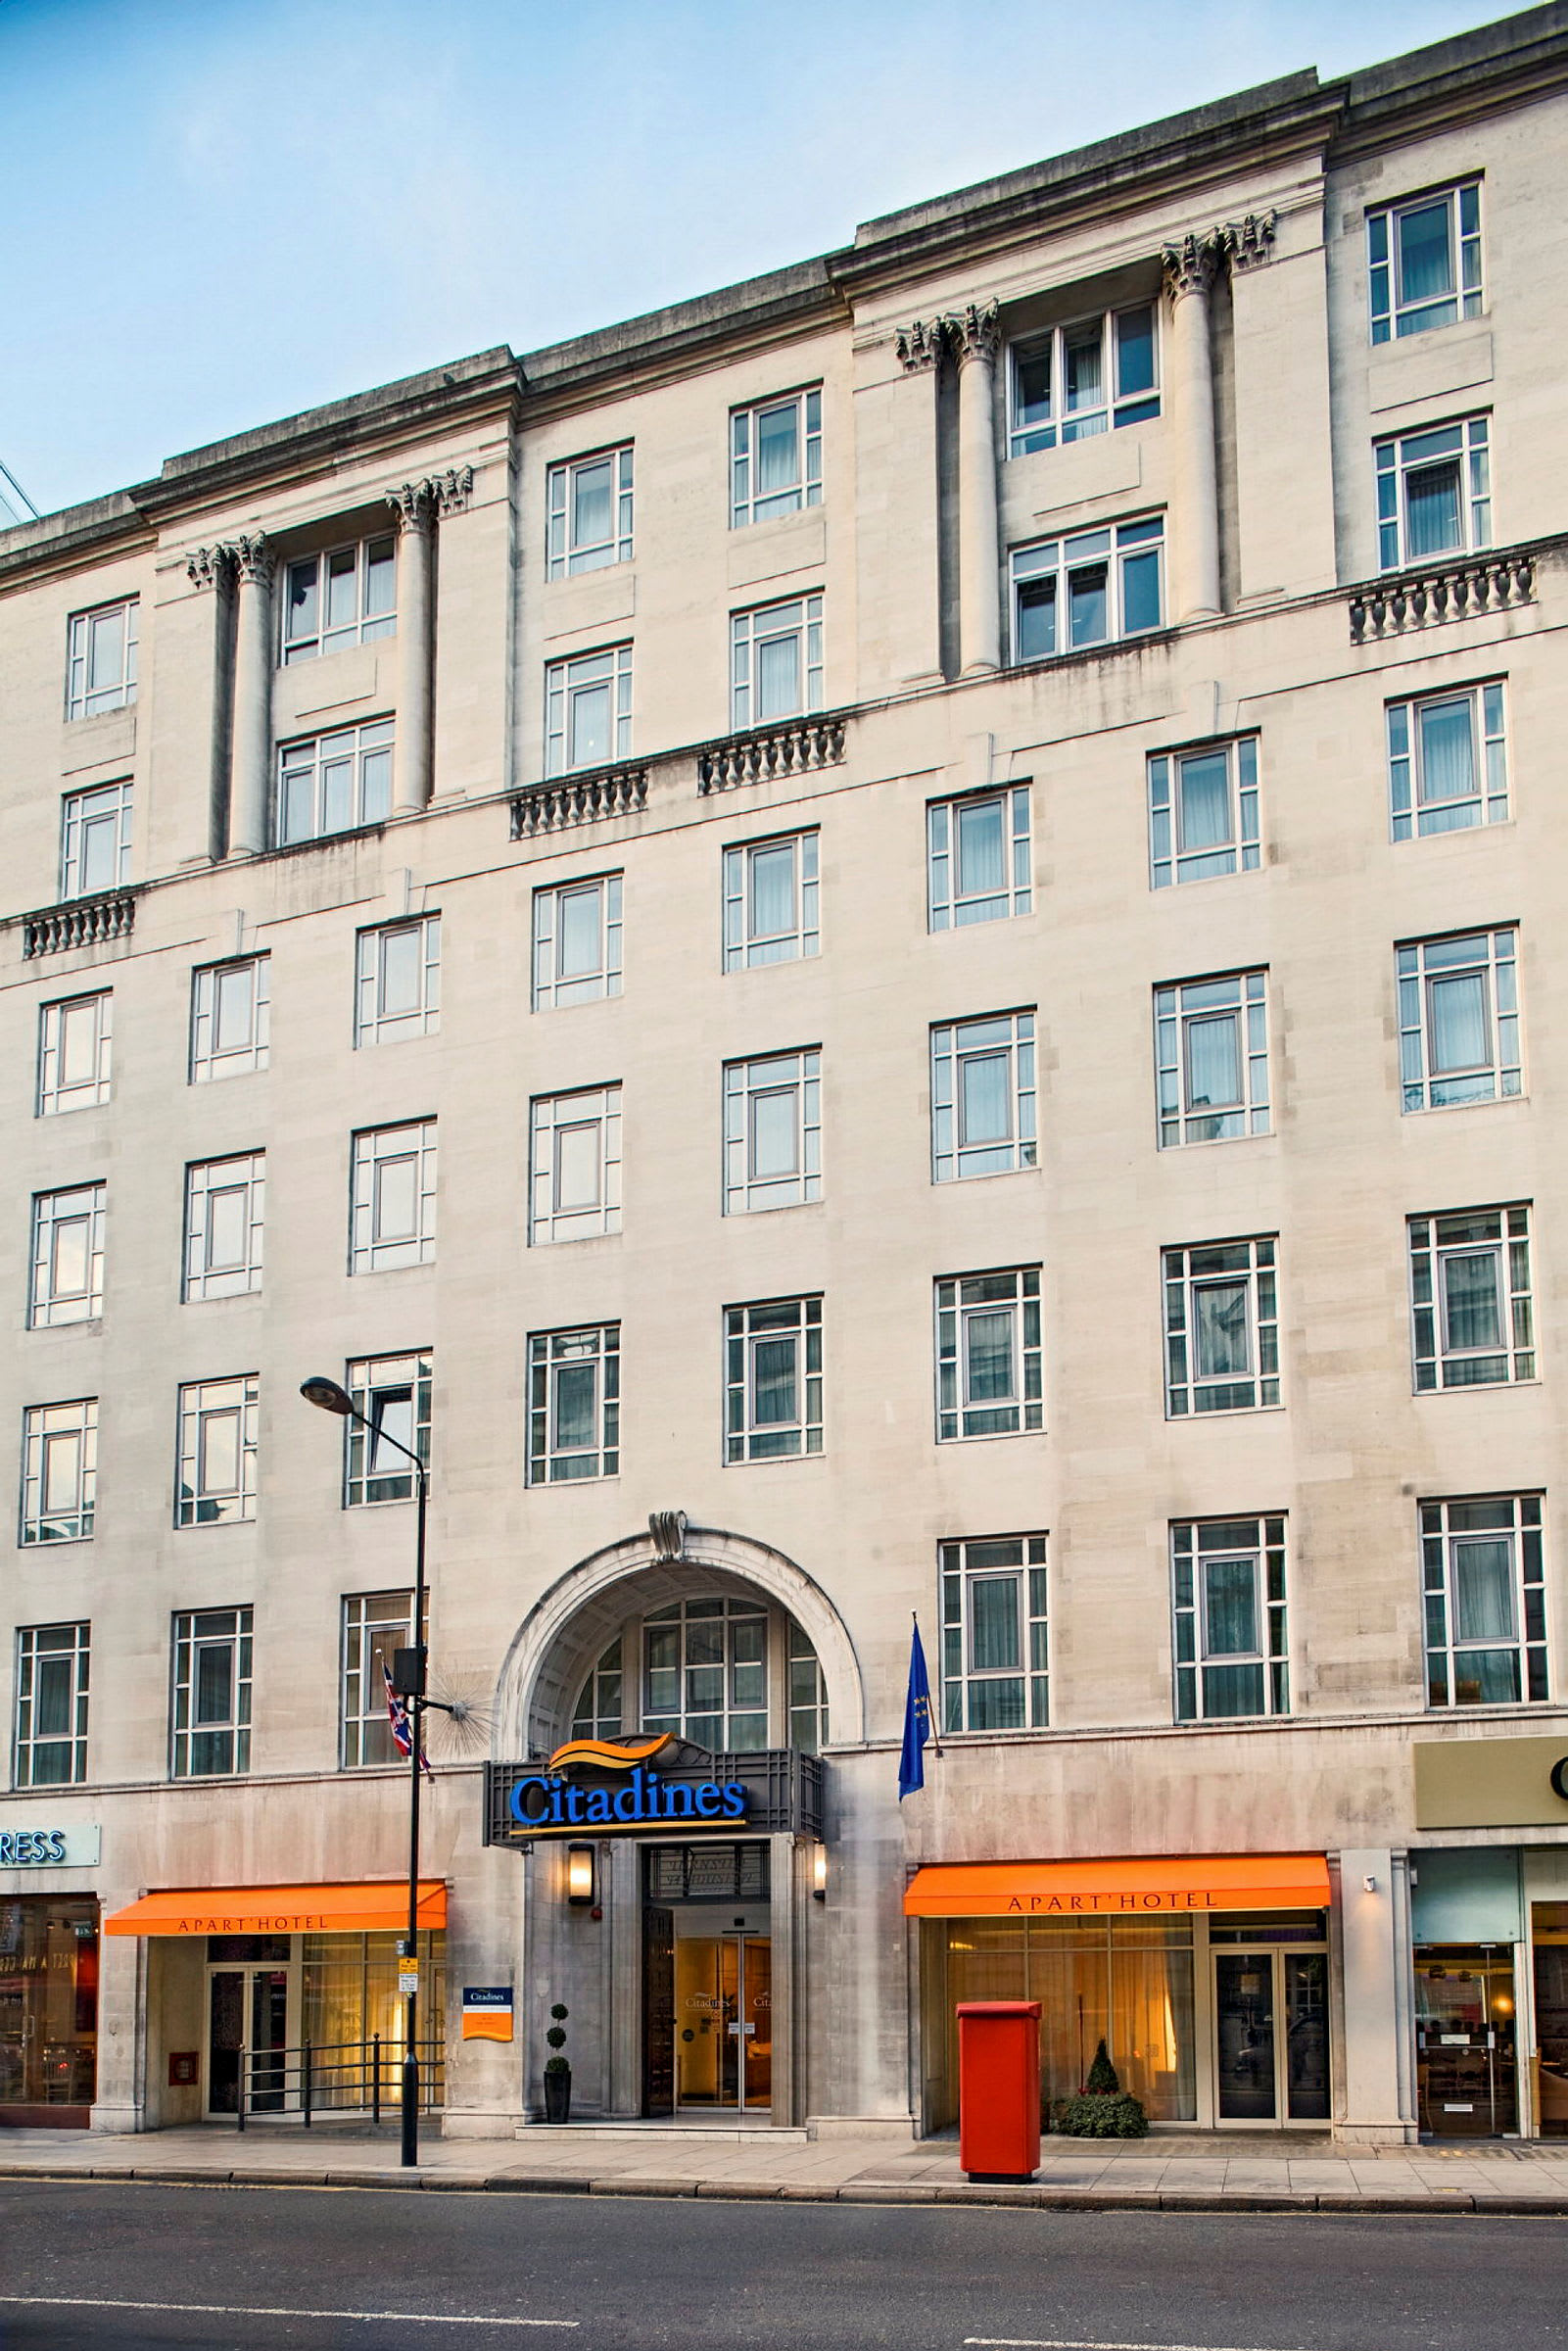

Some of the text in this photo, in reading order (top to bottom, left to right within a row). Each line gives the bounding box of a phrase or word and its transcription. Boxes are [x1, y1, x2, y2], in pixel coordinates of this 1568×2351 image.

[509, 1767, 746, 1824] Citadines
[1008, 1893, 1217, 1911] APART'HOTEL
[178, 1915, 328, 1932] APART'HOTEL
